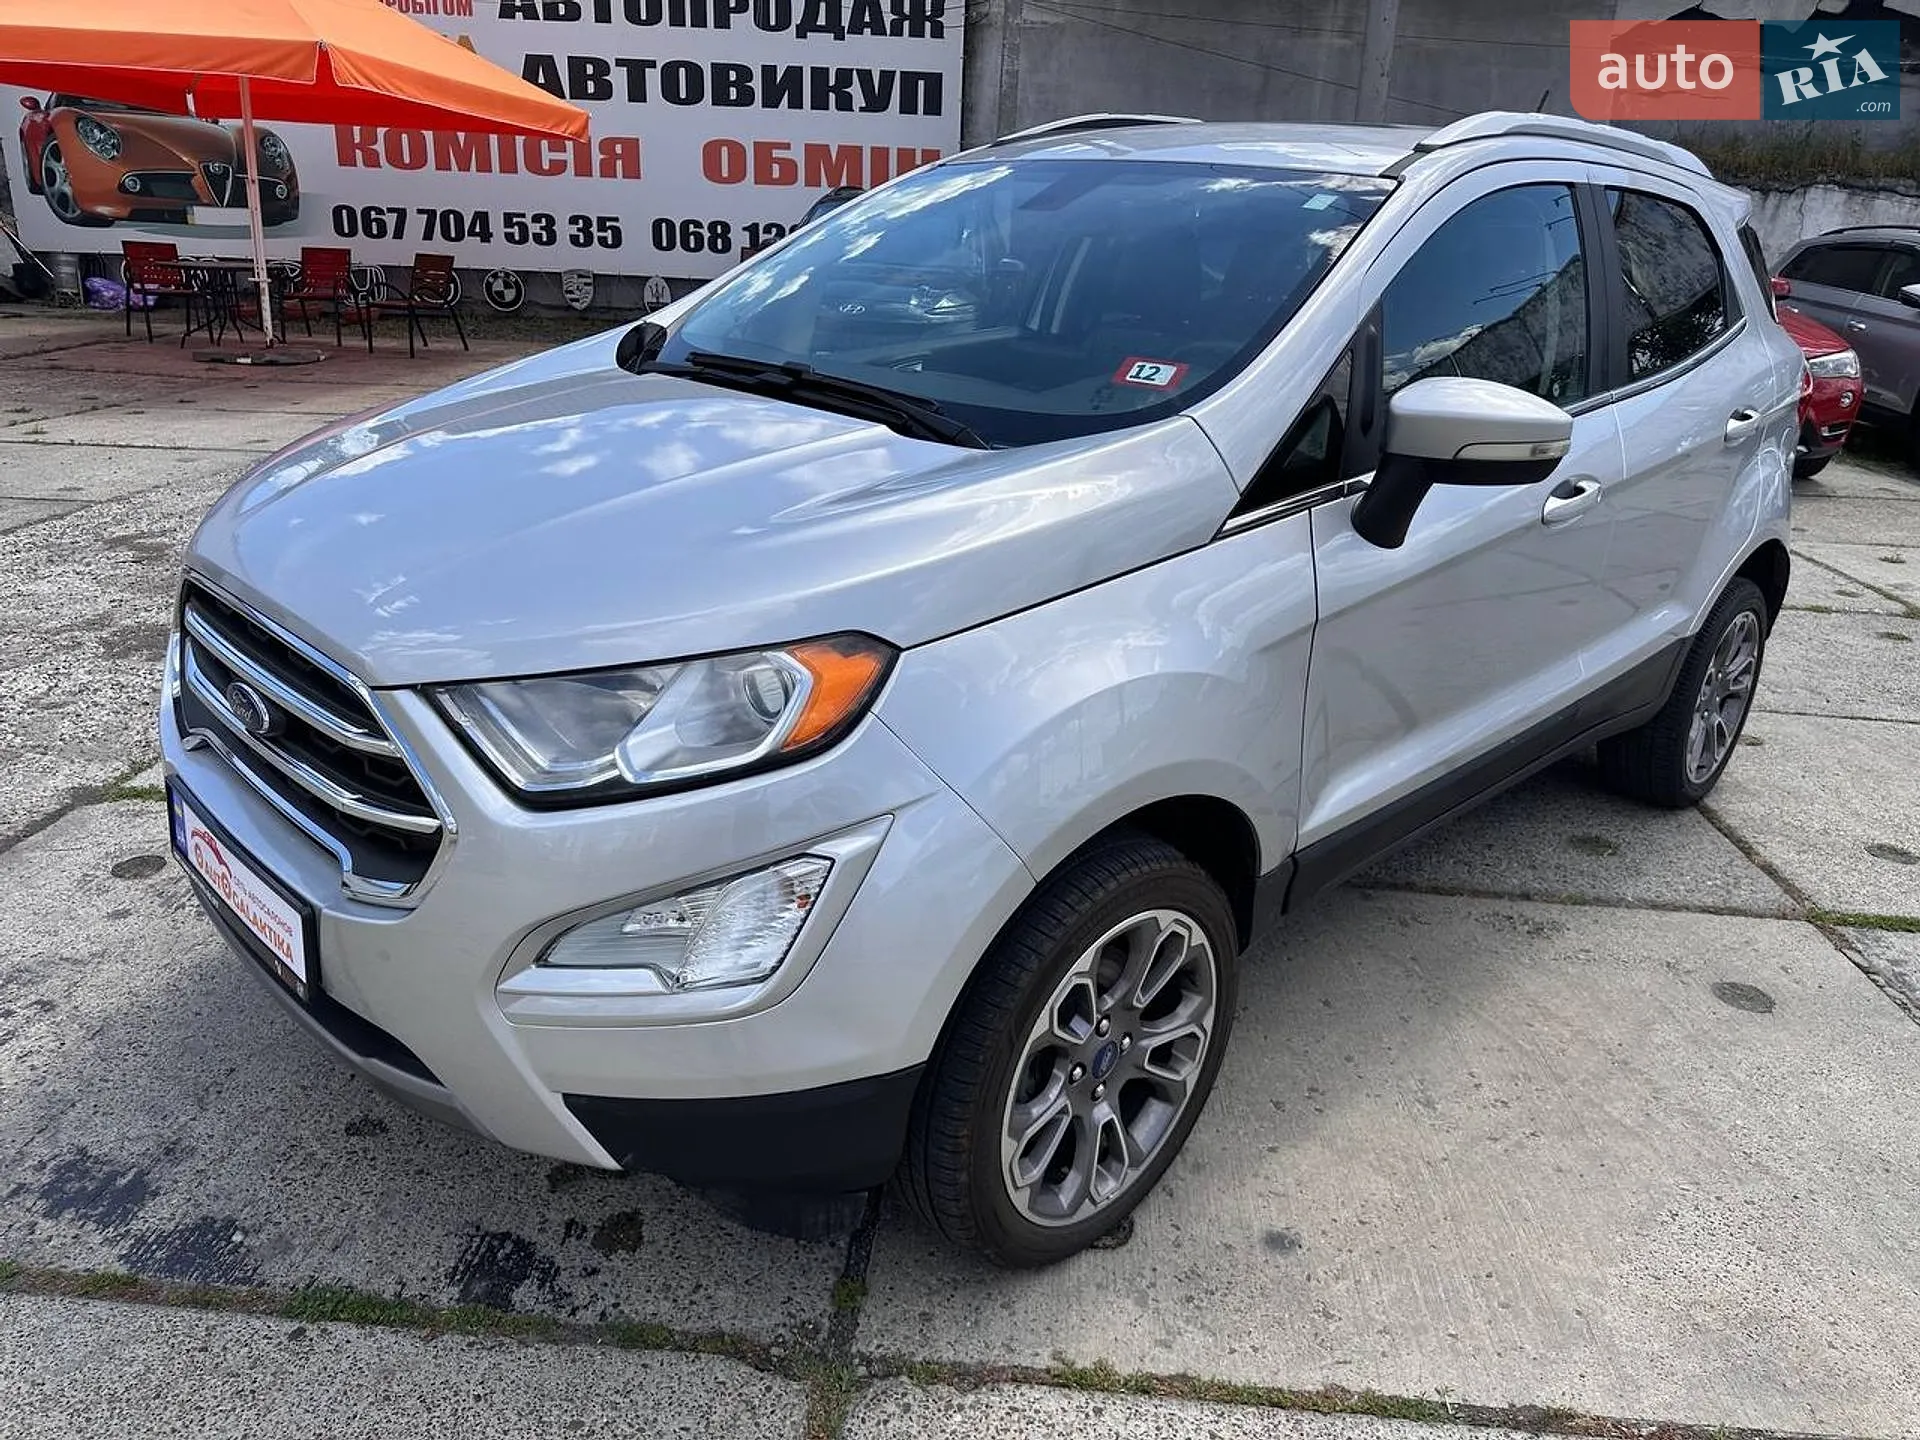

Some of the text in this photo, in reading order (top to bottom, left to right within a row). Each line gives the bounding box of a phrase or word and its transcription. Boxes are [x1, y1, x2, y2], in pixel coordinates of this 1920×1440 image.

[380, 0, 474, 17] ОБІГОМ
[521, 53, 943, 117] АВТОВИКУП
[334, 123, 642, 180] КОМІСІЯ
[332, 204, 801, 254] 067 704 53 35 068 12
[1129, 364, 1161, 381] 12
